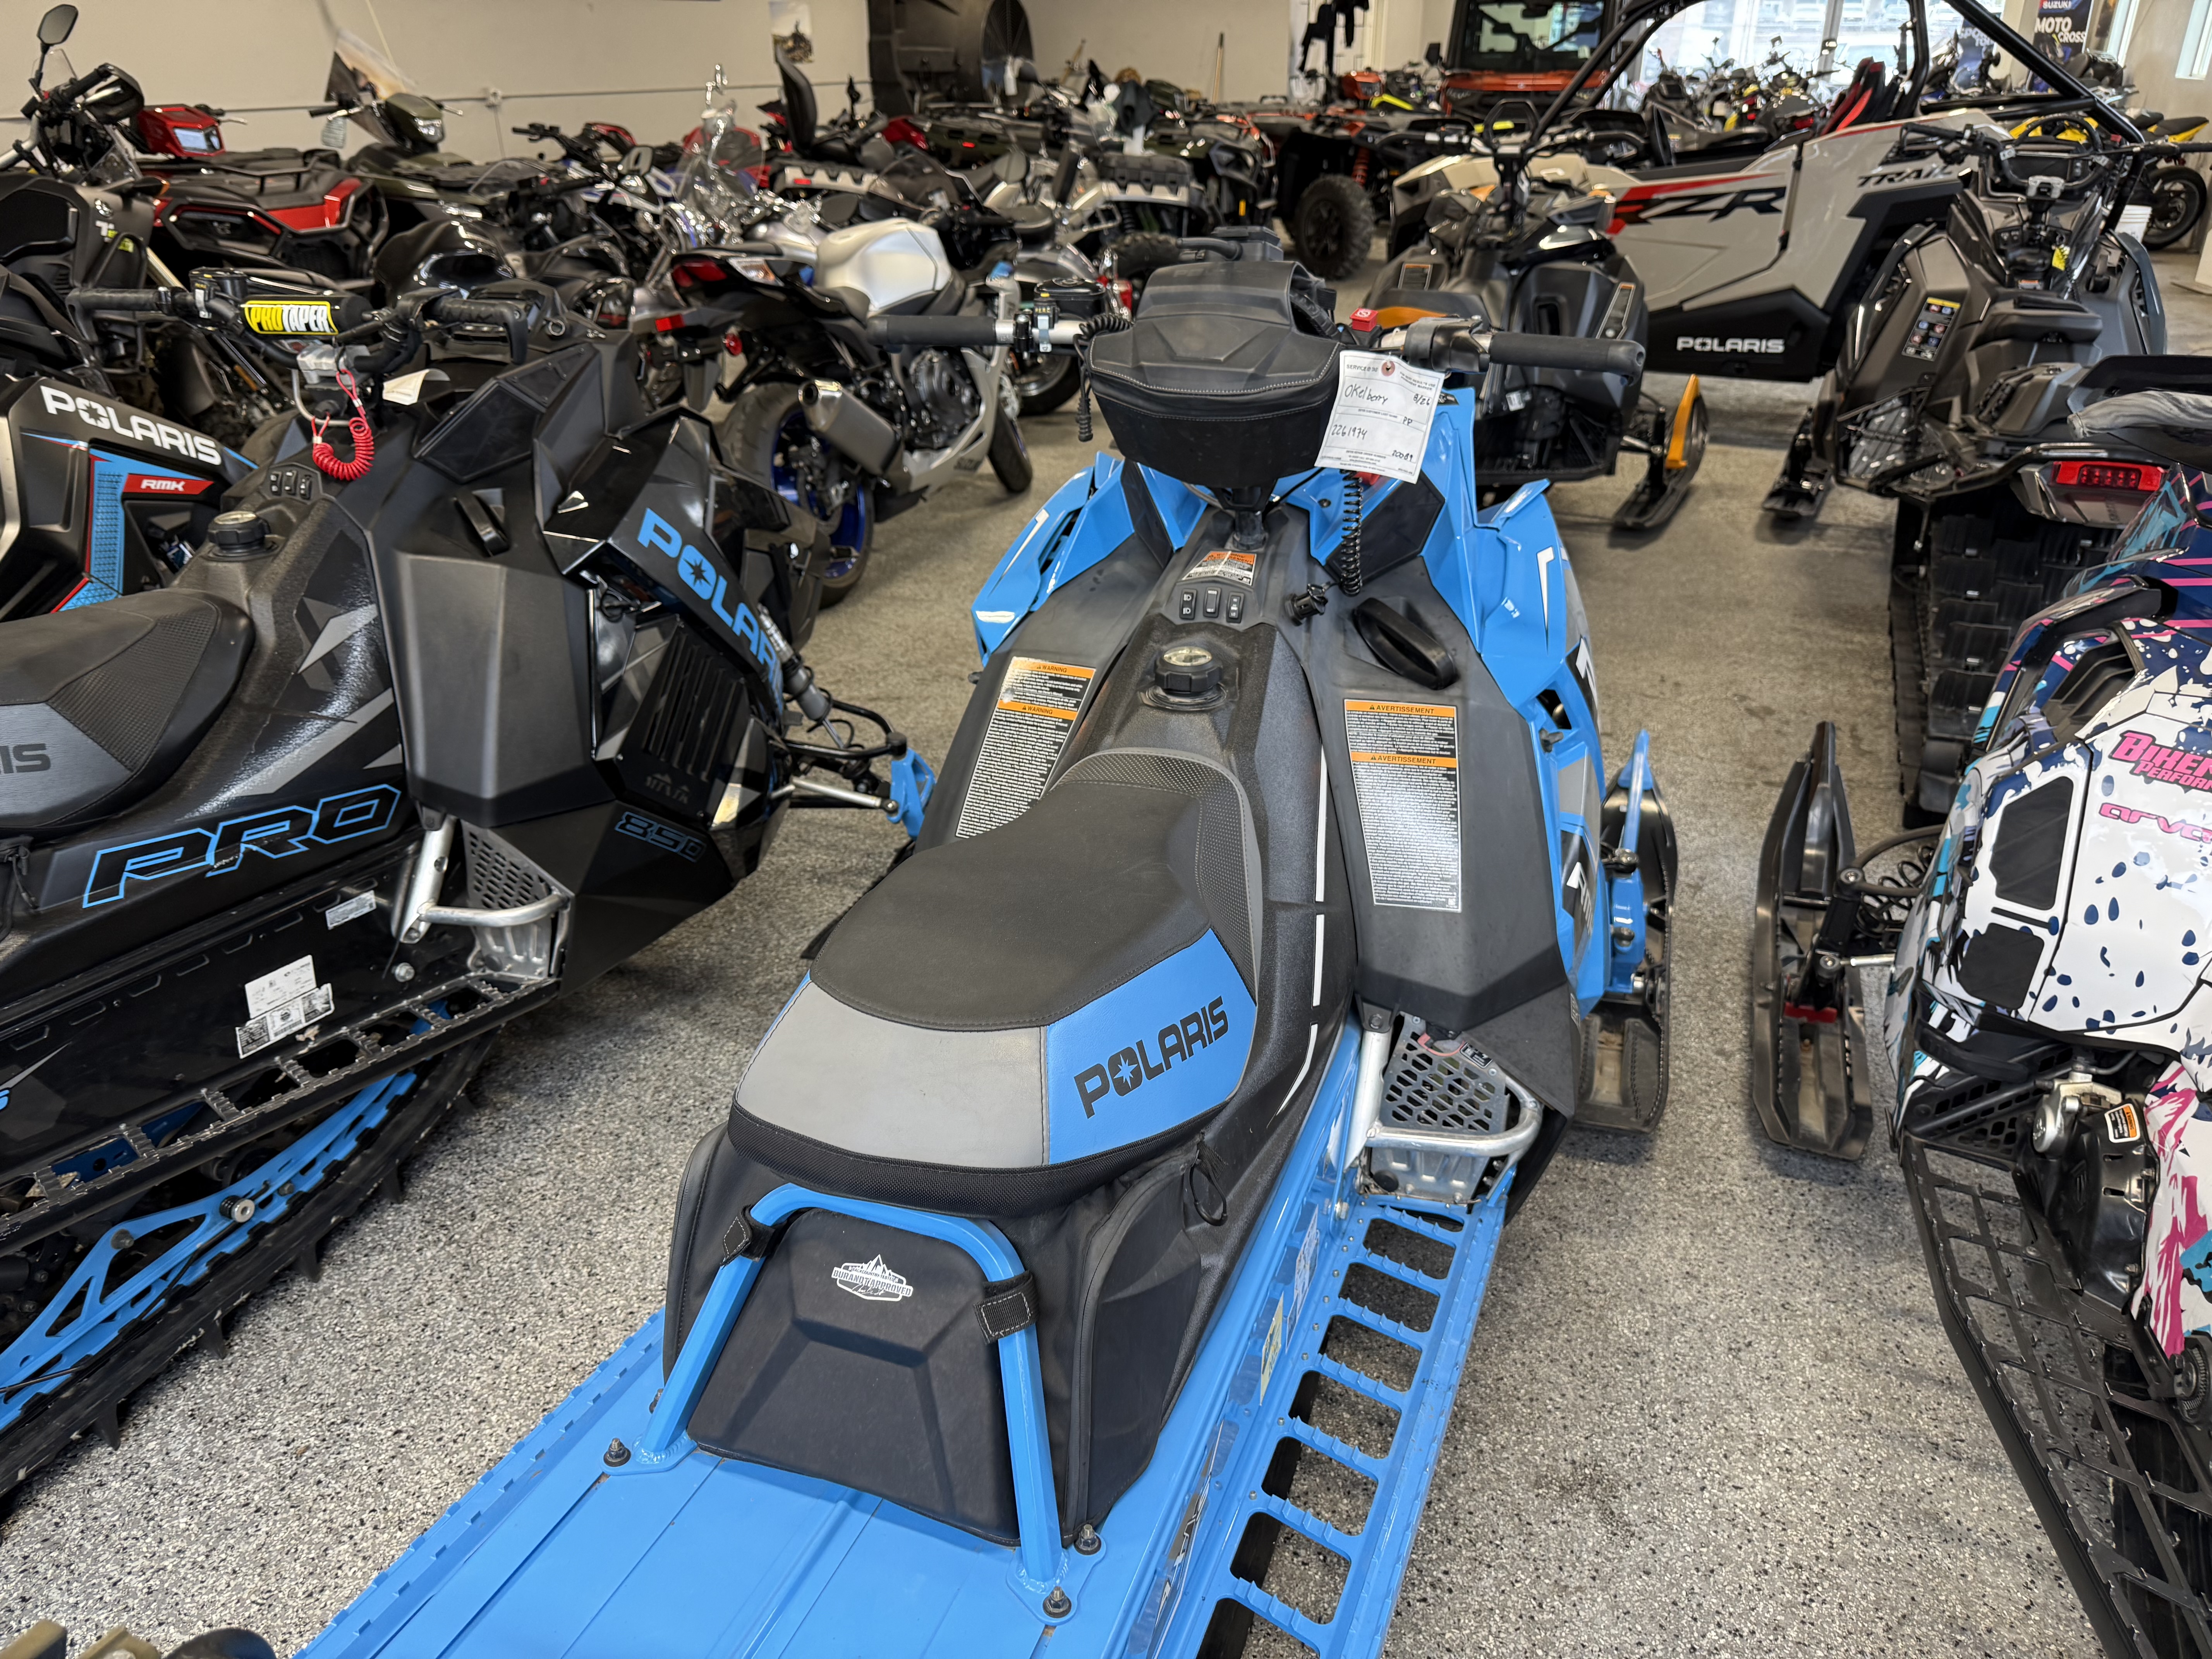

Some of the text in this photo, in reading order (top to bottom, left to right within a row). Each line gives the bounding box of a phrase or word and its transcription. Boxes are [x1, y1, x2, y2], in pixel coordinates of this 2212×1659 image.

[2043, 0, 2071, 9] SUZUKI
[2034, 17, 2072, 33] MOTO
[2057, 31, 2086, 43] CROSS
[1676, 337, 1785, 354] POLARIS
[40, 385, 222, 465] POLARIS
[140, 479, 186, 492] RMK
[1042, 665, 1067, 673] WARNING
[1027, 706, 1053, 714] WARNING
[1376, 705, 1434, 714] AVERTISSEMENT
[1377, 755, 1436, 764] AVERTISSEMENT
[82, 783, 401, 908] PRO
[1073, 995, 1229, 1119] POLARIS
[833, 1269, 869, 1286] BURANDT
[870, 1279, 911, 1296] APPROVED
